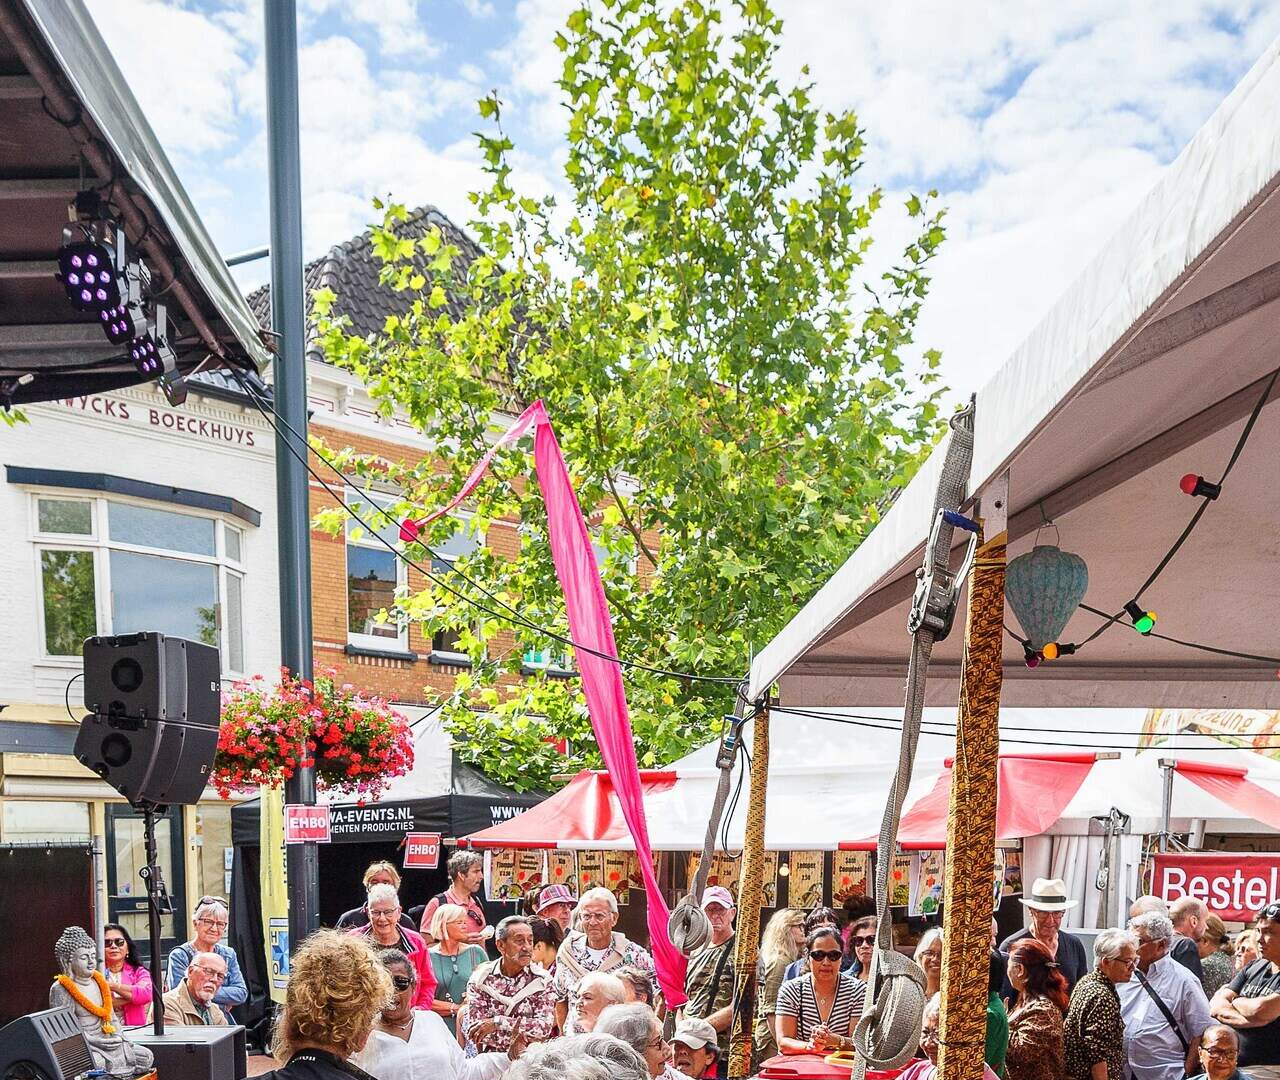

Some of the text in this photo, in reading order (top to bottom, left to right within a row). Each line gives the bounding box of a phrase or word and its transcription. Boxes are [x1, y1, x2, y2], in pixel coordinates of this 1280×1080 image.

[149, 408, 255, 446] BOECKHUYS
[489, 806, 529, 818] WWW
[289, 816, 326, 829] EHBO
[361, 821, 415, 833] PRODUCTIES
[409, 844, 436, 856] EHBO
